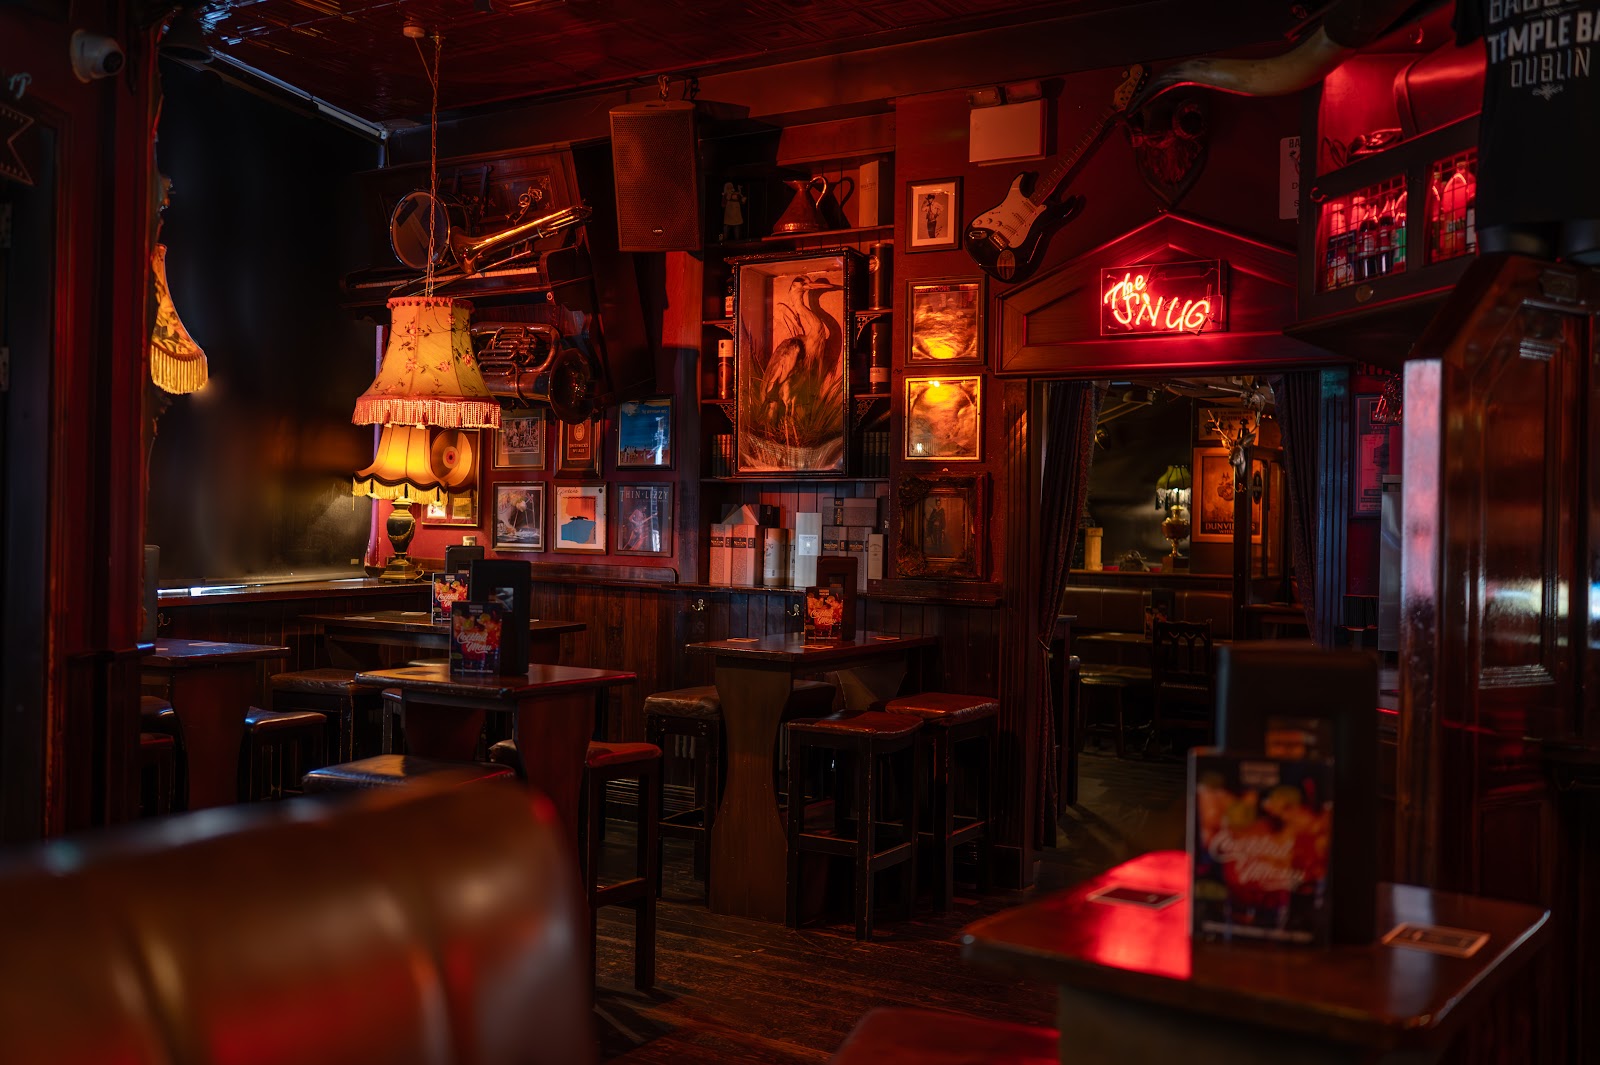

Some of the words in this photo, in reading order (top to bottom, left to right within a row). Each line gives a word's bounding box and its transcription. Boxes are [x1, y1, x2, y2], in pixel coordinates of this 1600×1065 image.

[1487, 15, 1573, 64] TEMPLE
[1510, 46, 1591, 88] DUBLIN
[1112, 292, 1210, 332] SNUG
[620, 490, 641, 502] THIN
[645, 490, 669, 500] LIZZY
[466, 641, 493, 654] Menu
